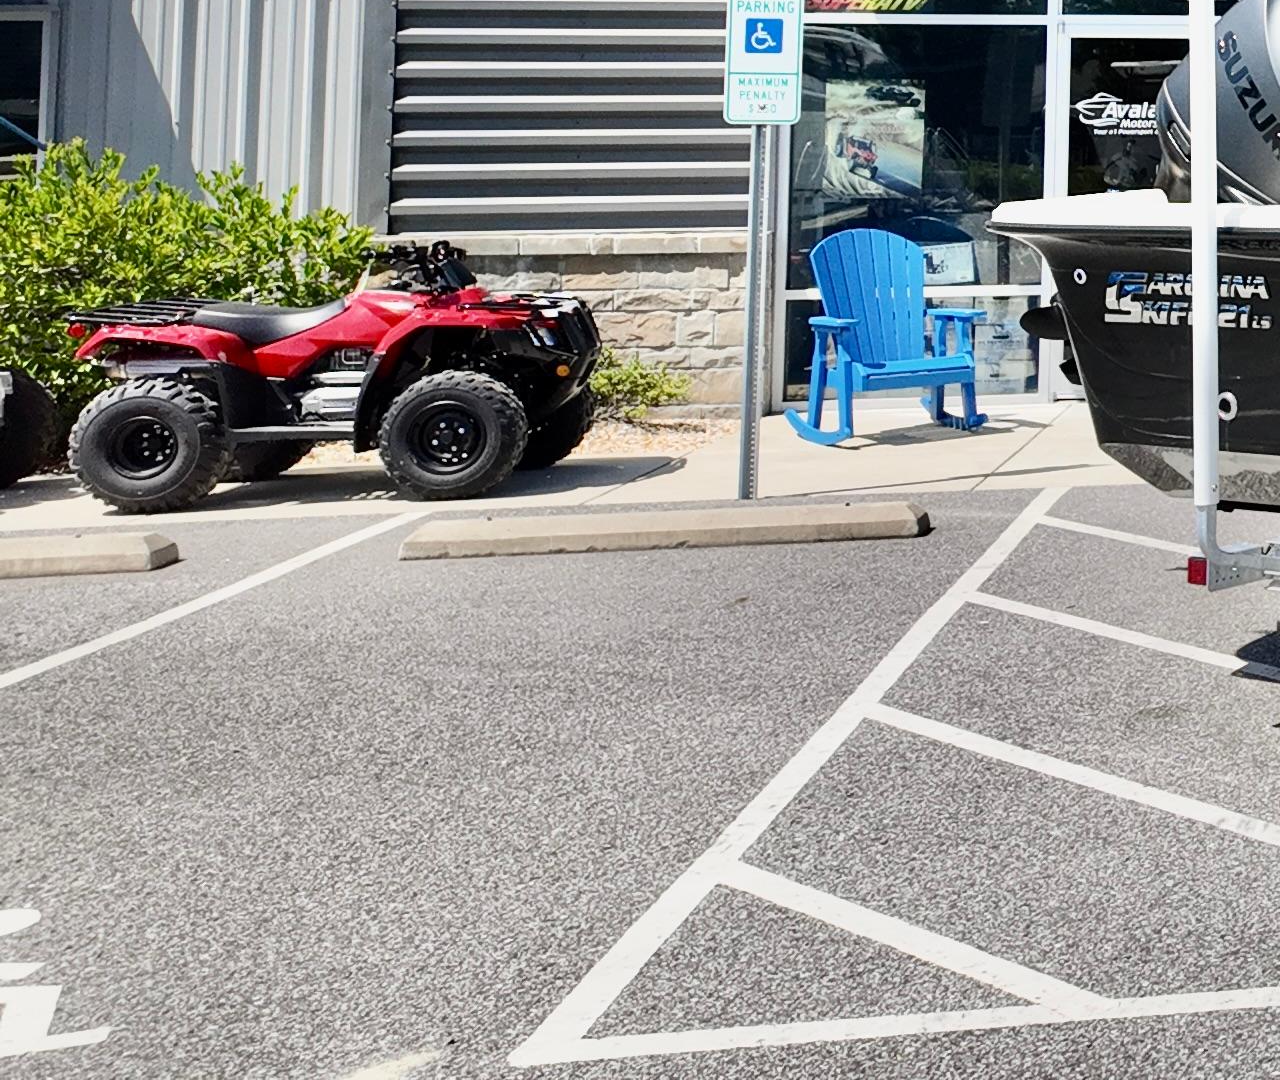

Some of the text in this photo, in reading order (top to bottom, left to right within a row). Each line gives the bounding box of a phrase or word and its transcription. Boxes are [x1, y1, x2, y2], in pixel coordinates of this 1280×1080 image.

[736, 0, 795, 14] PARKING
[738, 78, 789, 86] MAXIMUM
[739, 90, 787, 100] PENALTY
